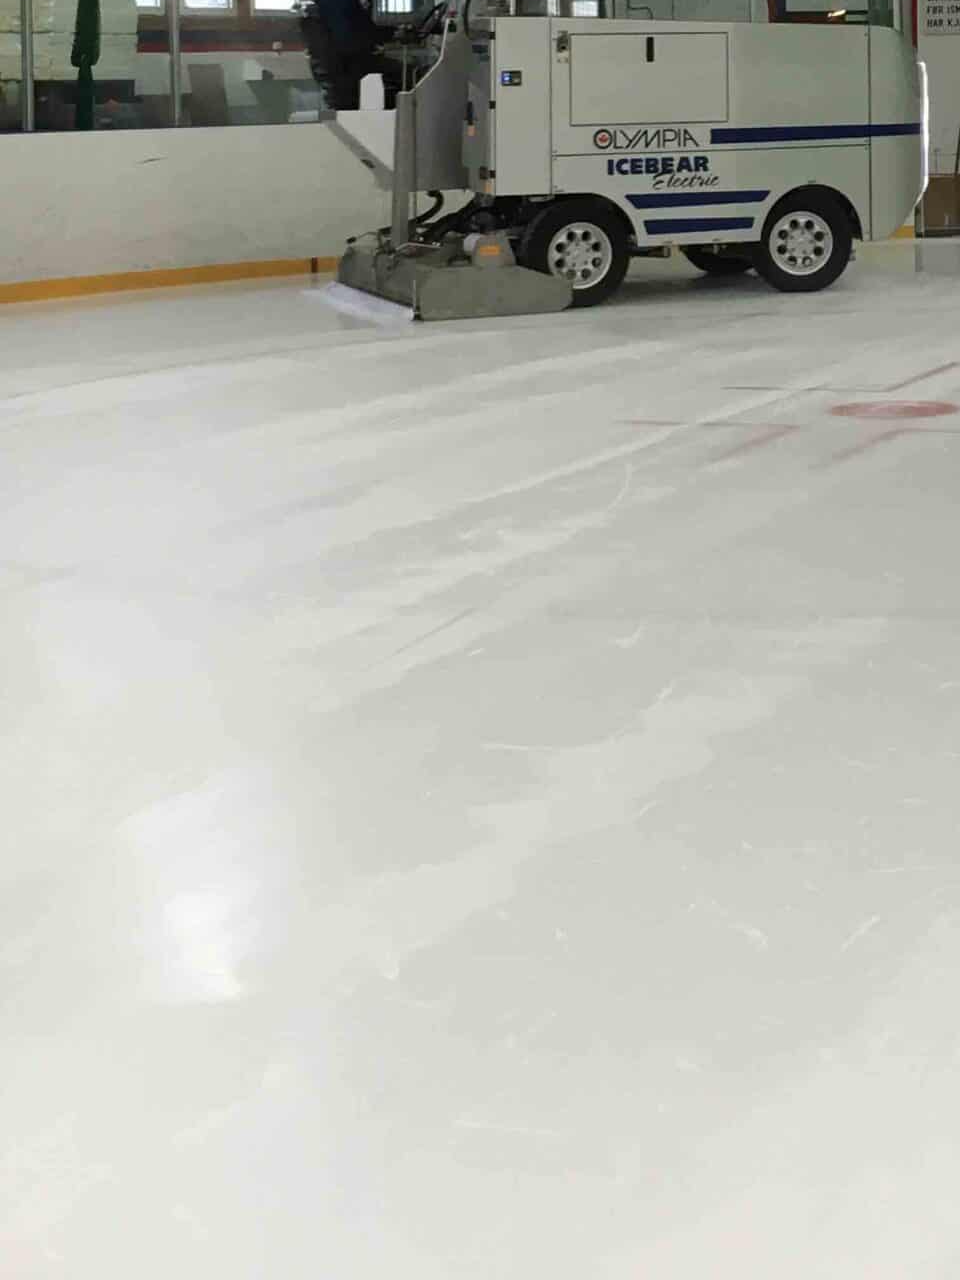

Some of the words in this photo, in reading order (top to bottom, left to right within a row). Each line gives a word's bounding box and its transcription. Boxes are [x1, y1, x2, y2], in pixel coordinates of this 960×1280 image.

[593, 128, 700, 150] OLYMPIA
[607, 156, 710, 176] ICEBEAR
[652, 171, 720, 190] Electric
